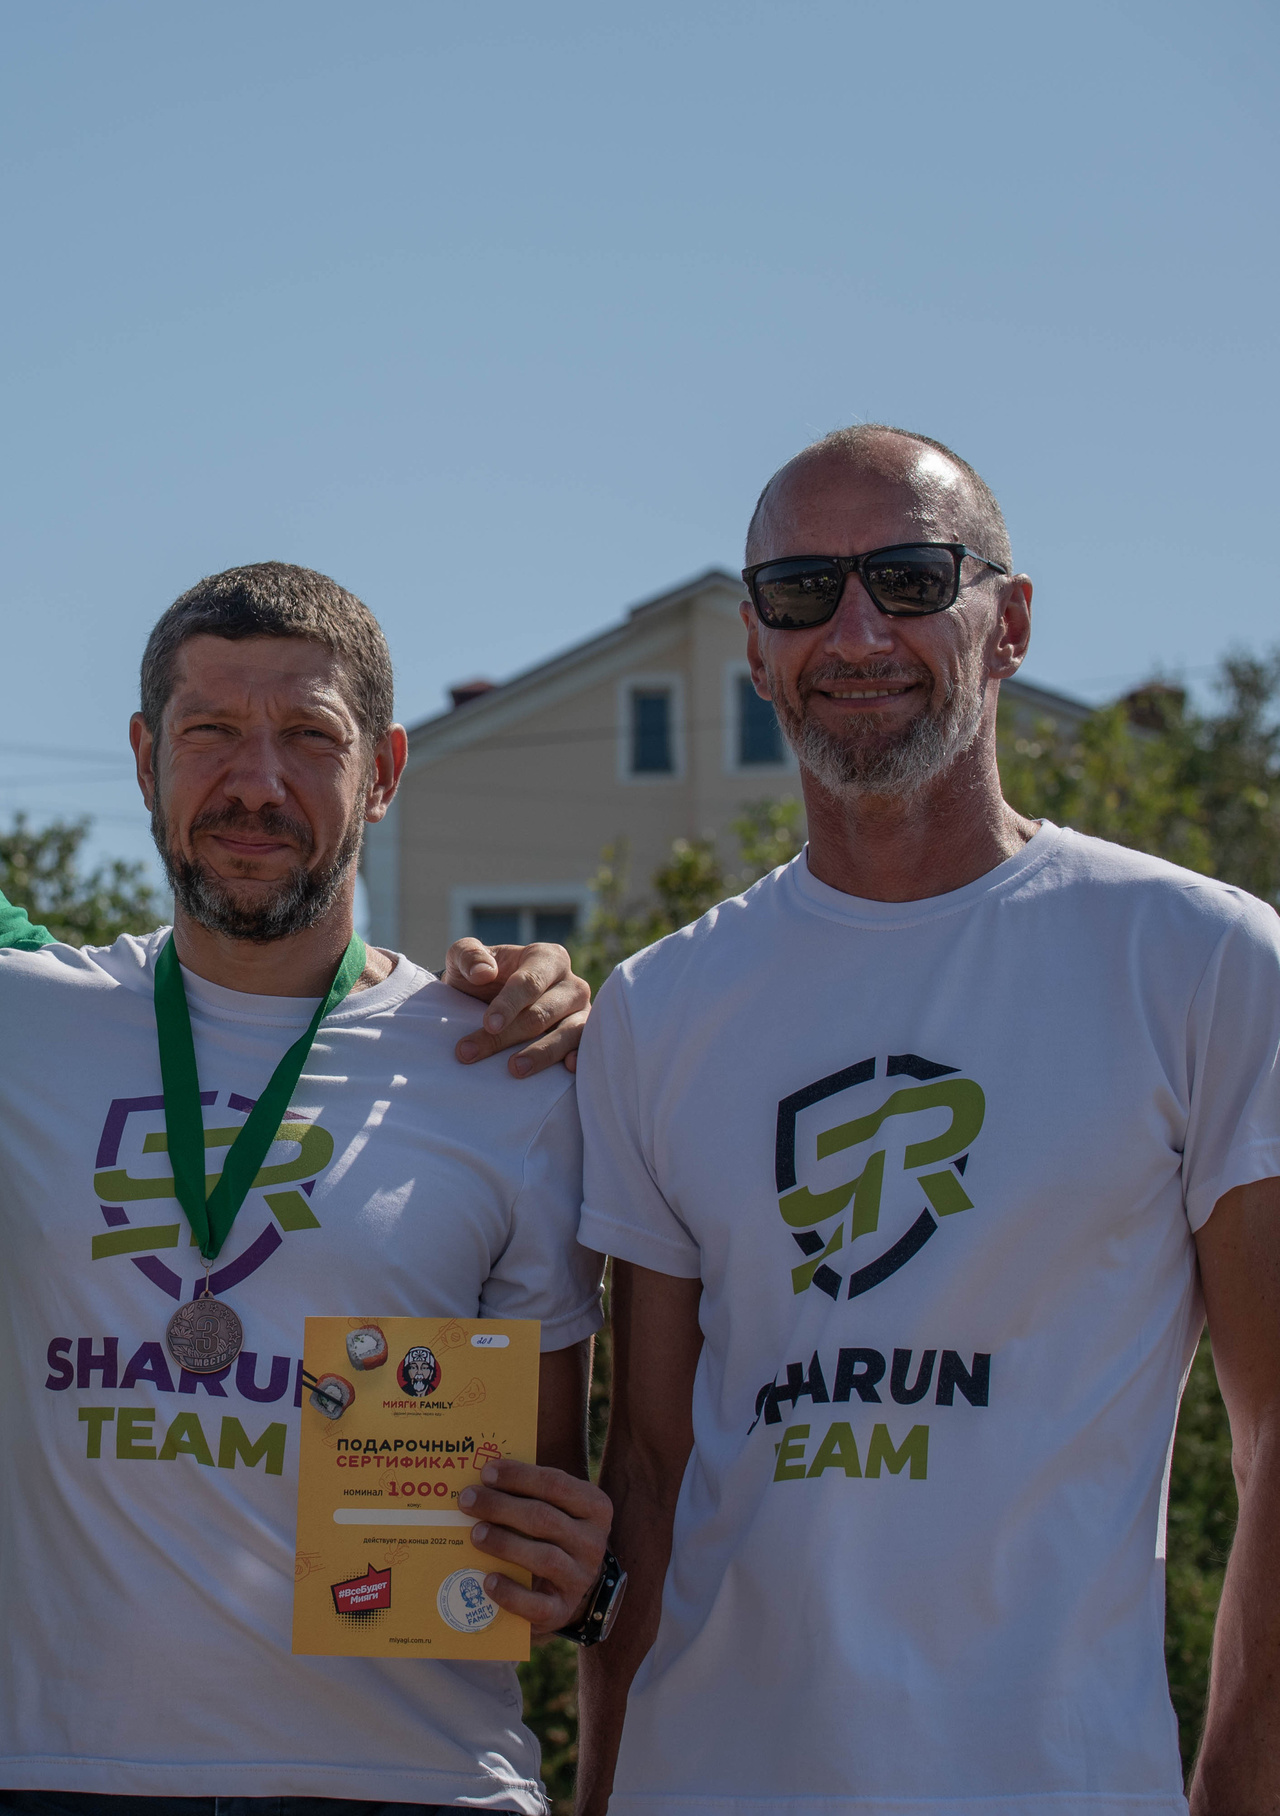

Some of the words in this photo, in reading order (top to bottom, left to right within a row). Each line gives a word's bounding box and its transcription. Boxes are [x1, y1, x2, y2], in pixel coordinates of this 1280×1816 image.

[195, 1315, 220, 1354] 3
[45, 1337, 303, 1408] SHARU
[382, 1400, 417, 1409] МИЯГИ
[419, 1401, 454, 1409] FAMILY
[78, 1407, 288, 1476] TEAM
[337, 1436, 475, 1455] ПОДАРОЧНЫЙ
[772, 1421, 930, 1483] EAM
[336, 1455, 469, 1469] СЕРТИФИКАТ
[343, 1489, 383, 1497] номинал
[388, 1481, 449, 1497] 1000
[363, 1536, 397, 1545] действует
[430, 1538, 447, 1546] 2022
